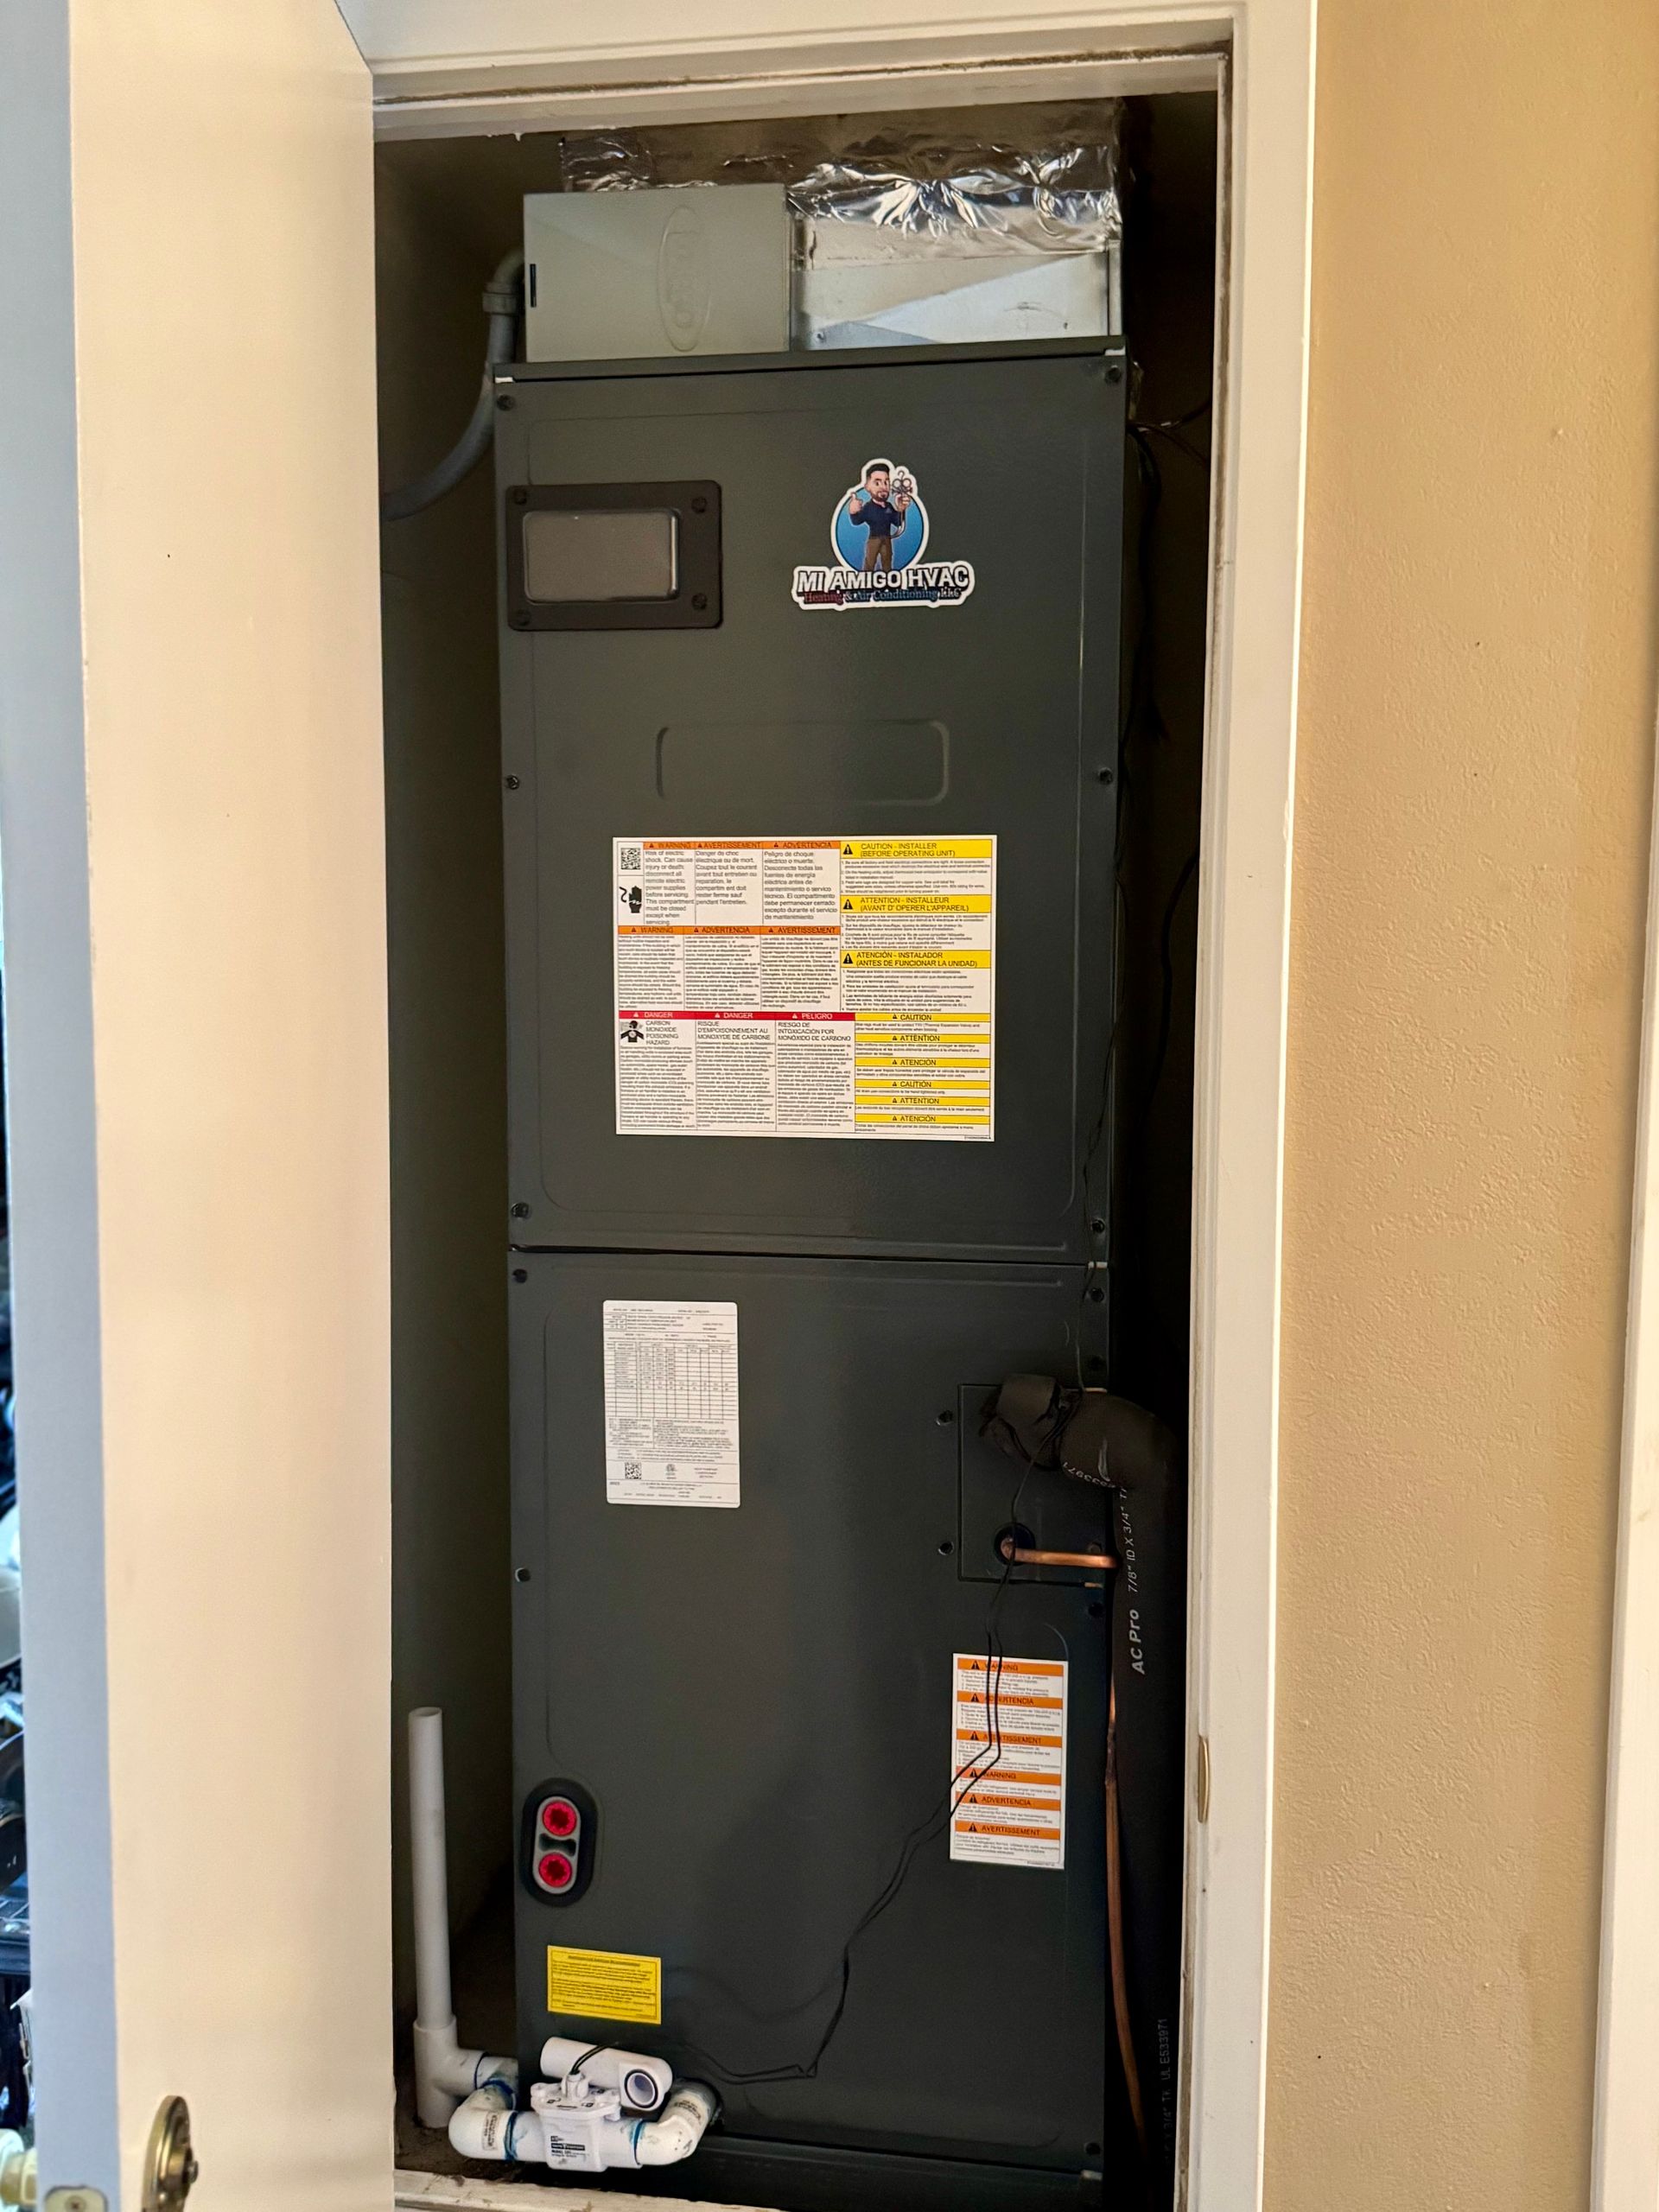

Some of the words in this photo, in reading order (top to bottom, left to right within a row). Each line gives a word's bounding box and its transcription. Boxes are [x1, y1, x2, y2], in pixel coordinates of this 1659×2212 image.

[798, 571, 825, 593] MI
[830, 570, 901, 590] AMIGO
[908, 567, 969, 588] HVAC
[804, 592, 842, 604] Heating
[845, 593, 855, 601] &
[855, 592, 869, 601] Air
[873, 589, 937, 602] Conditioning
[1121, 1506, 1132, 1534] 3/4"
[1126, 1548, 1135, 1561] ID
[1128, 1565, 1138, 1592] 7/8"
[1129, 1609, 1141, 1643] Pro
[1131, 1649, 1145, 1675] AC
[982, 1796, 1031, 1806] ADVERTENCIA
[982, 1825, 1040, 1835] AVERTISSEMENT
